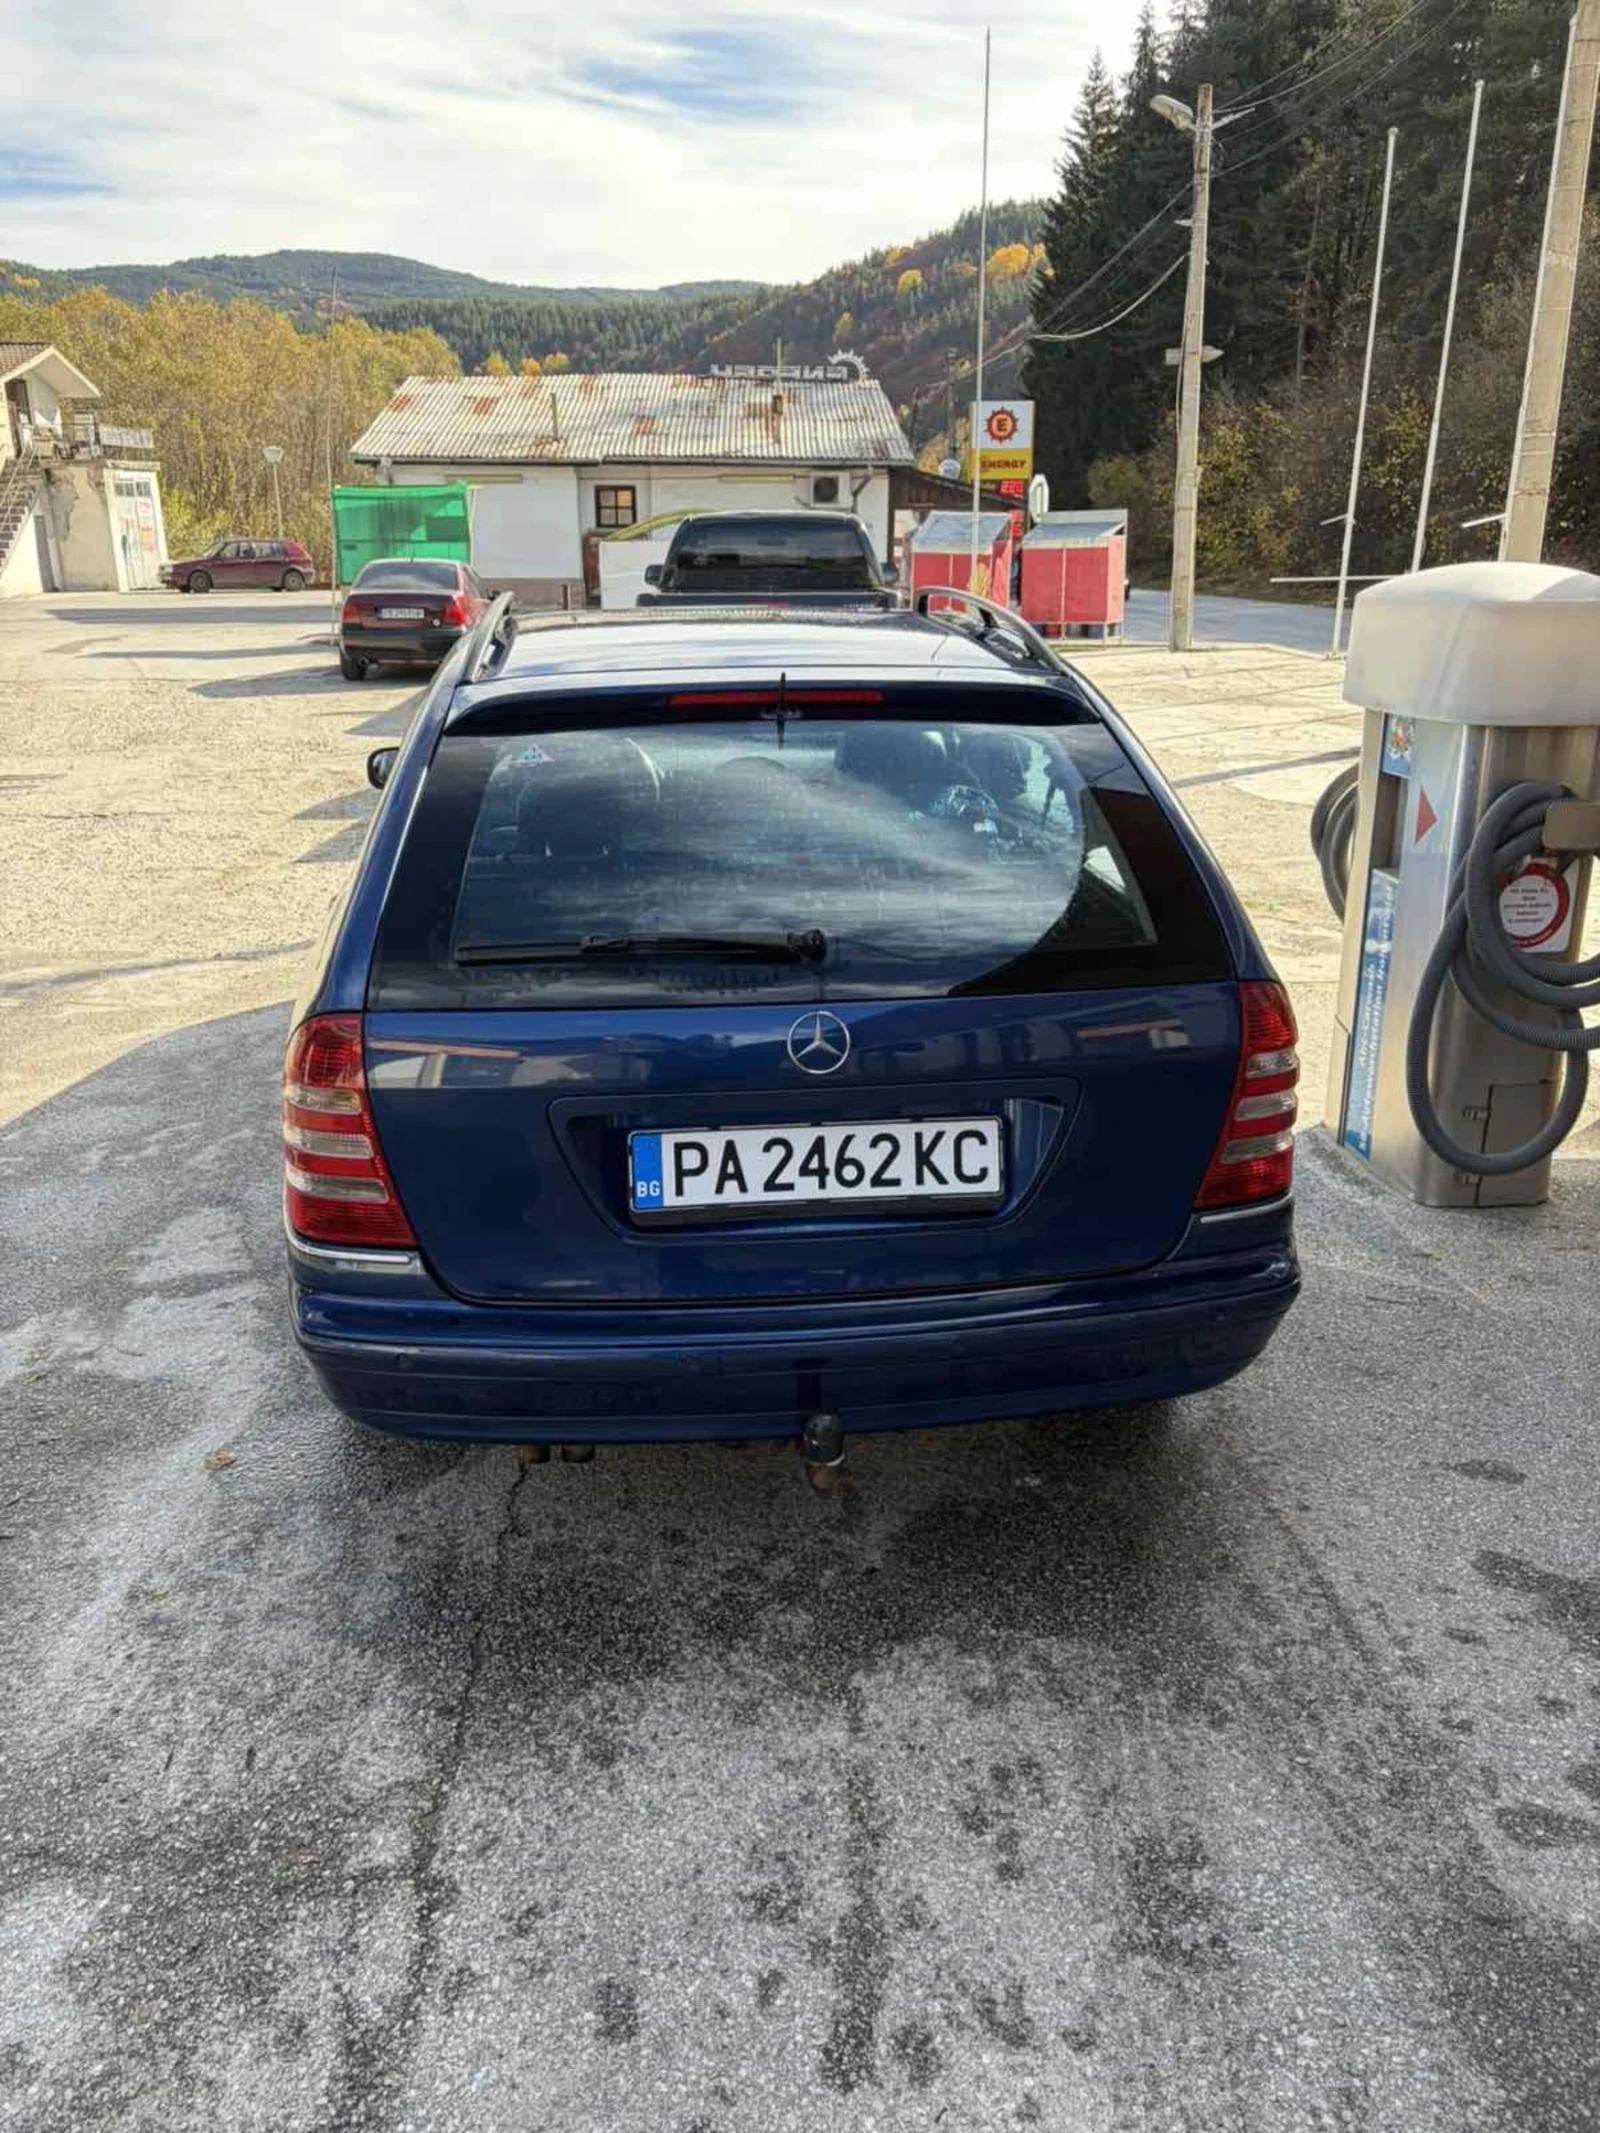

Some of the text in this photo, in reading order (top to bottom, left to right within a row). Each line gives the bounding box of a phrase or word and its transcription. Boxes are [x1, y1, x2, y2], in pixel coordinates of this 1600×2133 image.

[981, 459, 1026, 469] ENERGY
[673, 1129, 989, 1197] PA 2462 KC
[637, 1181, 660, 1197] BG
